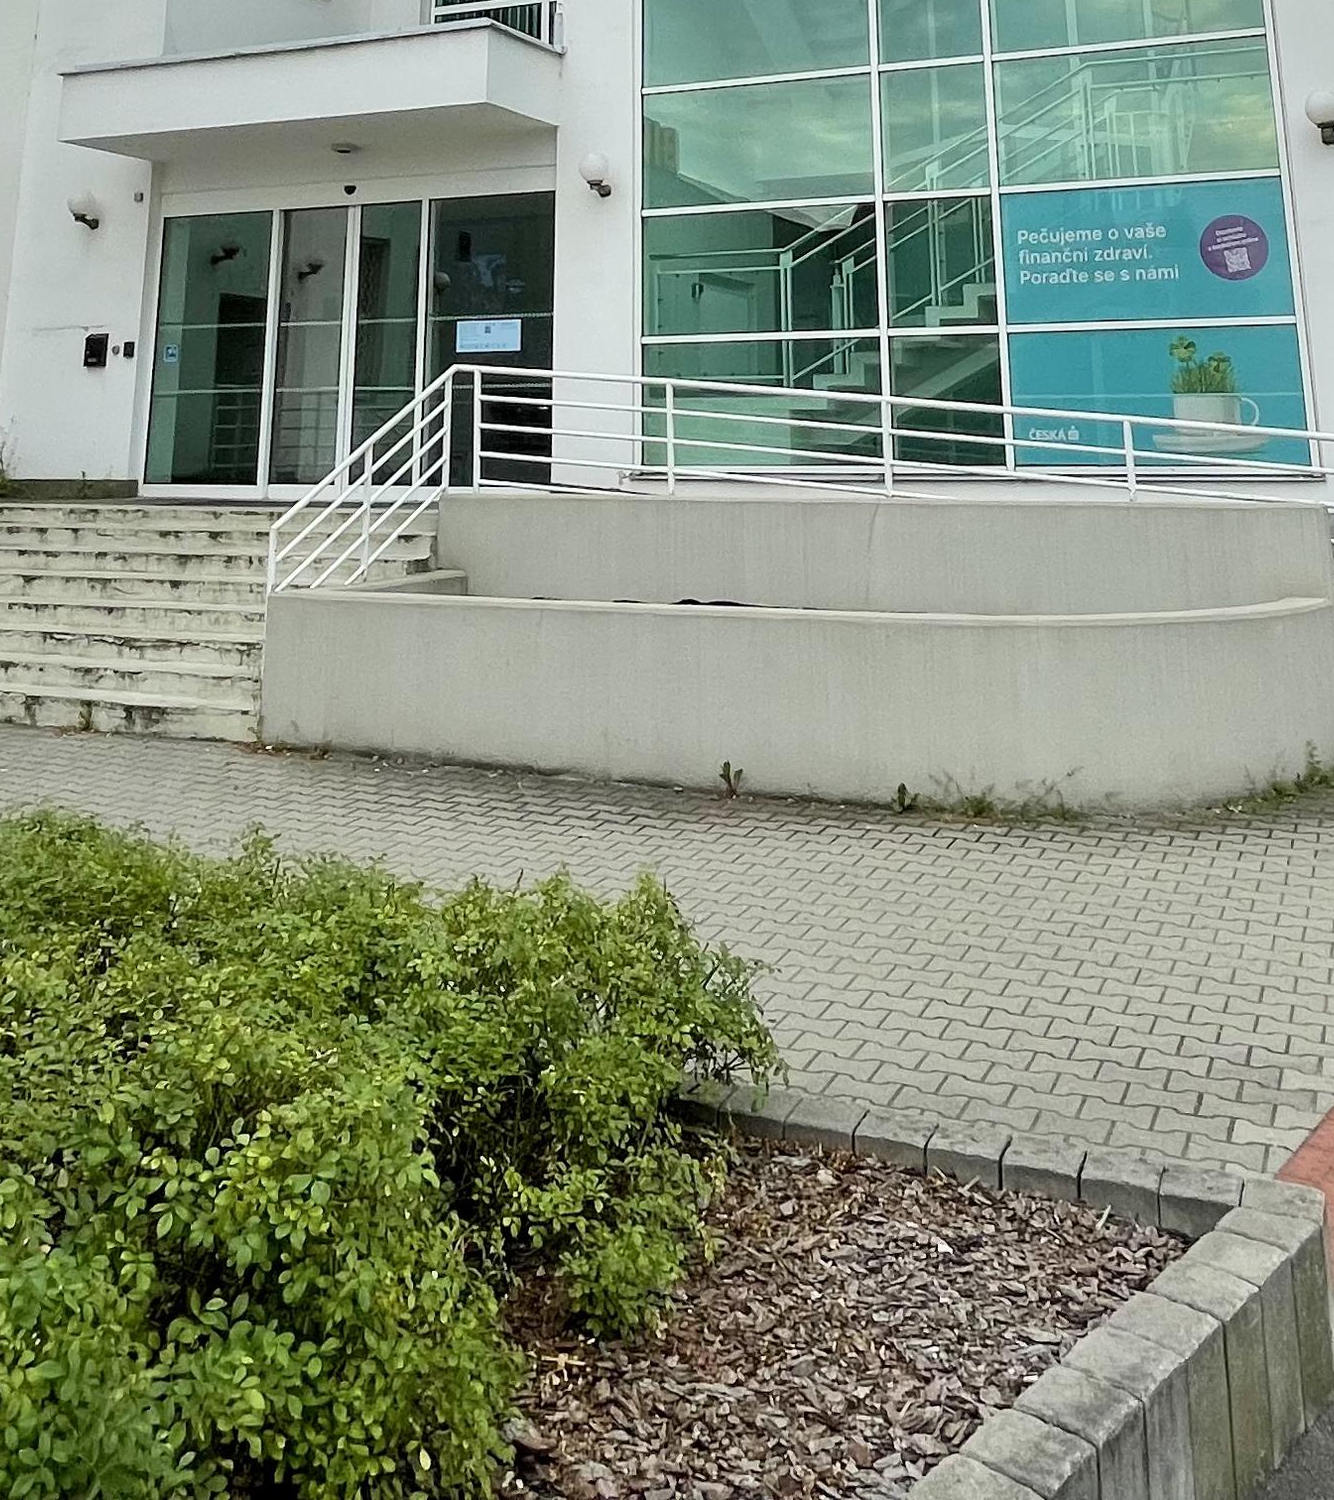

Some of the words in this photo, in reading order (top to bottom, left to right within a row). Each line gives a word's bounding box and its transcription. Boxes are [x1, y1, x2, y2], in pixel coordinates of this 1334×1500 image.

[1017, 228, 1102, 245] Pečujeme
[1108, 228, 1119, 239] o
[1124, 222, 1166, 239] vaše
[1094, 244, 1153, 262] zdraví.
[1094, 270, 1114, 282] se
[1120, 269, 1130, 281] s
[1135, 264, 1179, 281] námi
